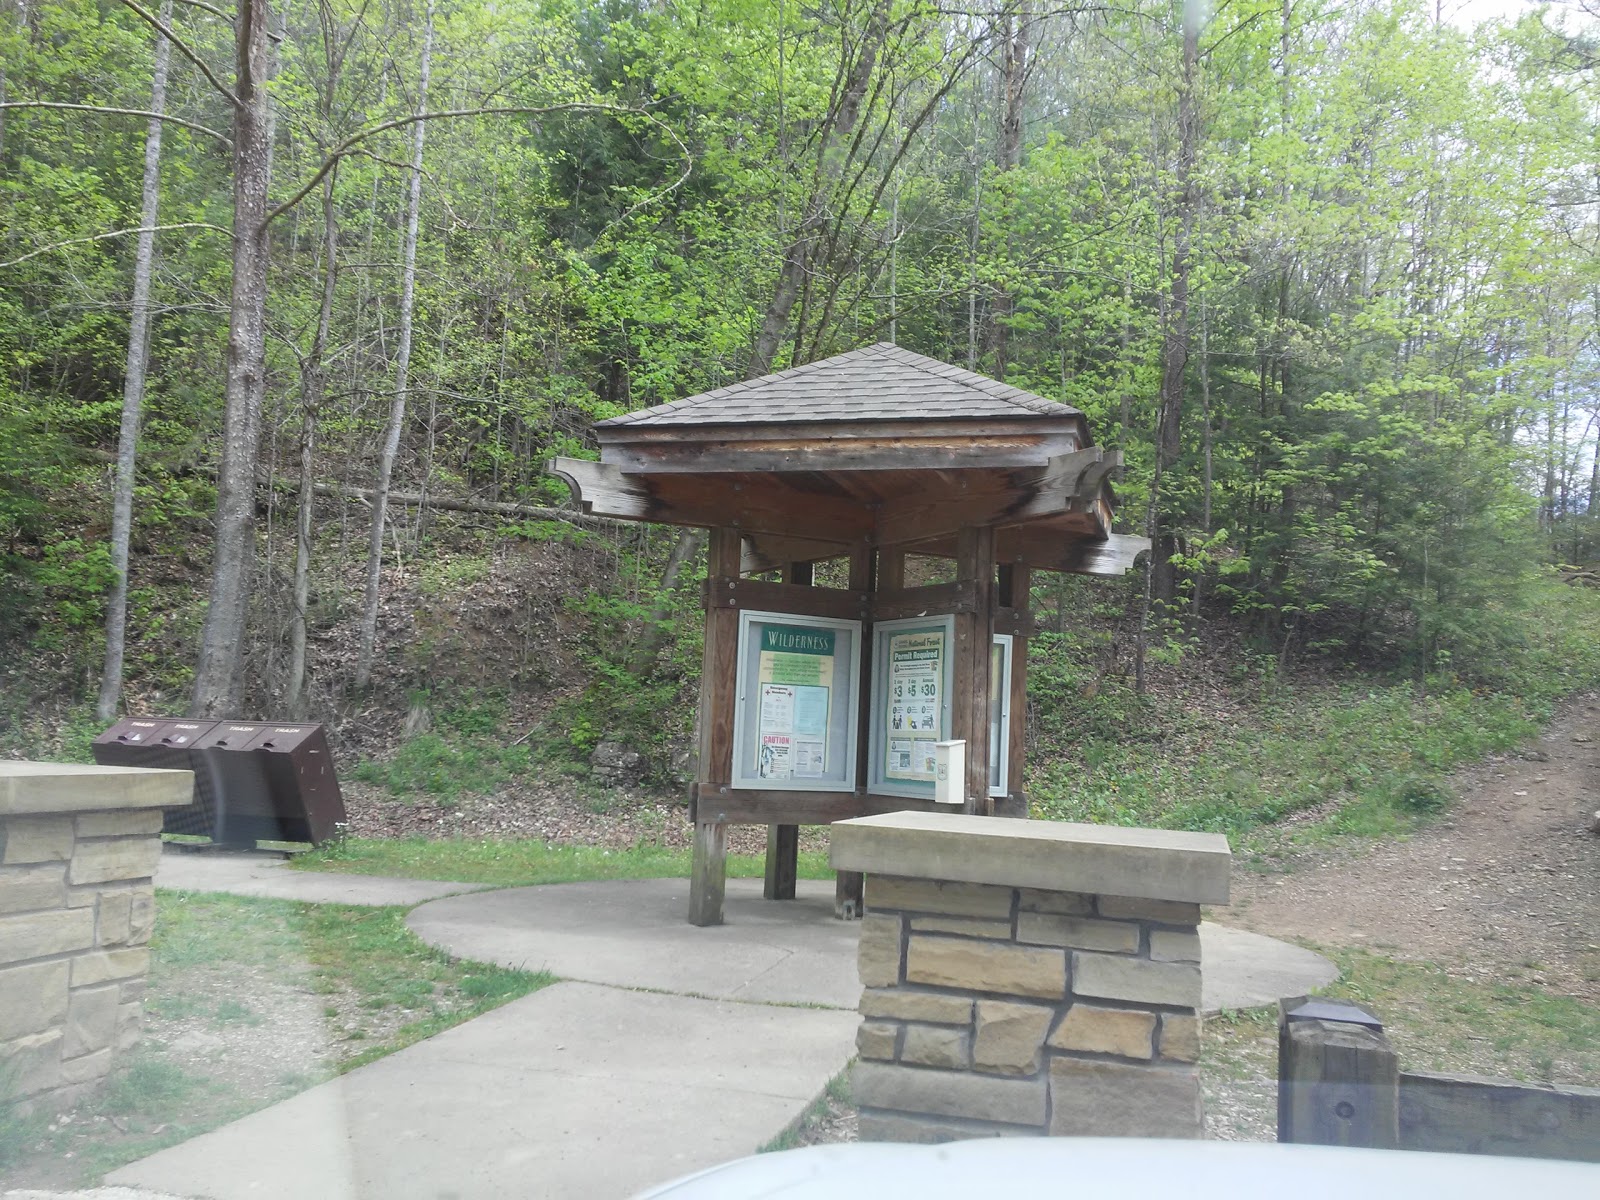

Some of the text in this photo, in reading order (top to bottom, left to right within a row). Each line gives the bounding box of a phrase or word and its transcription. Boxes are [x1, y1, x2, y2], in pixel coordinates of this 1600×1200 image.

[894, 650, 938, 661] Permit Required
[894, 685, 903, 697] $3
[907, 684, 917, 697] $5
[920, 683, 936, 697] $30
[763, 735, 790, 744] CAUTION
